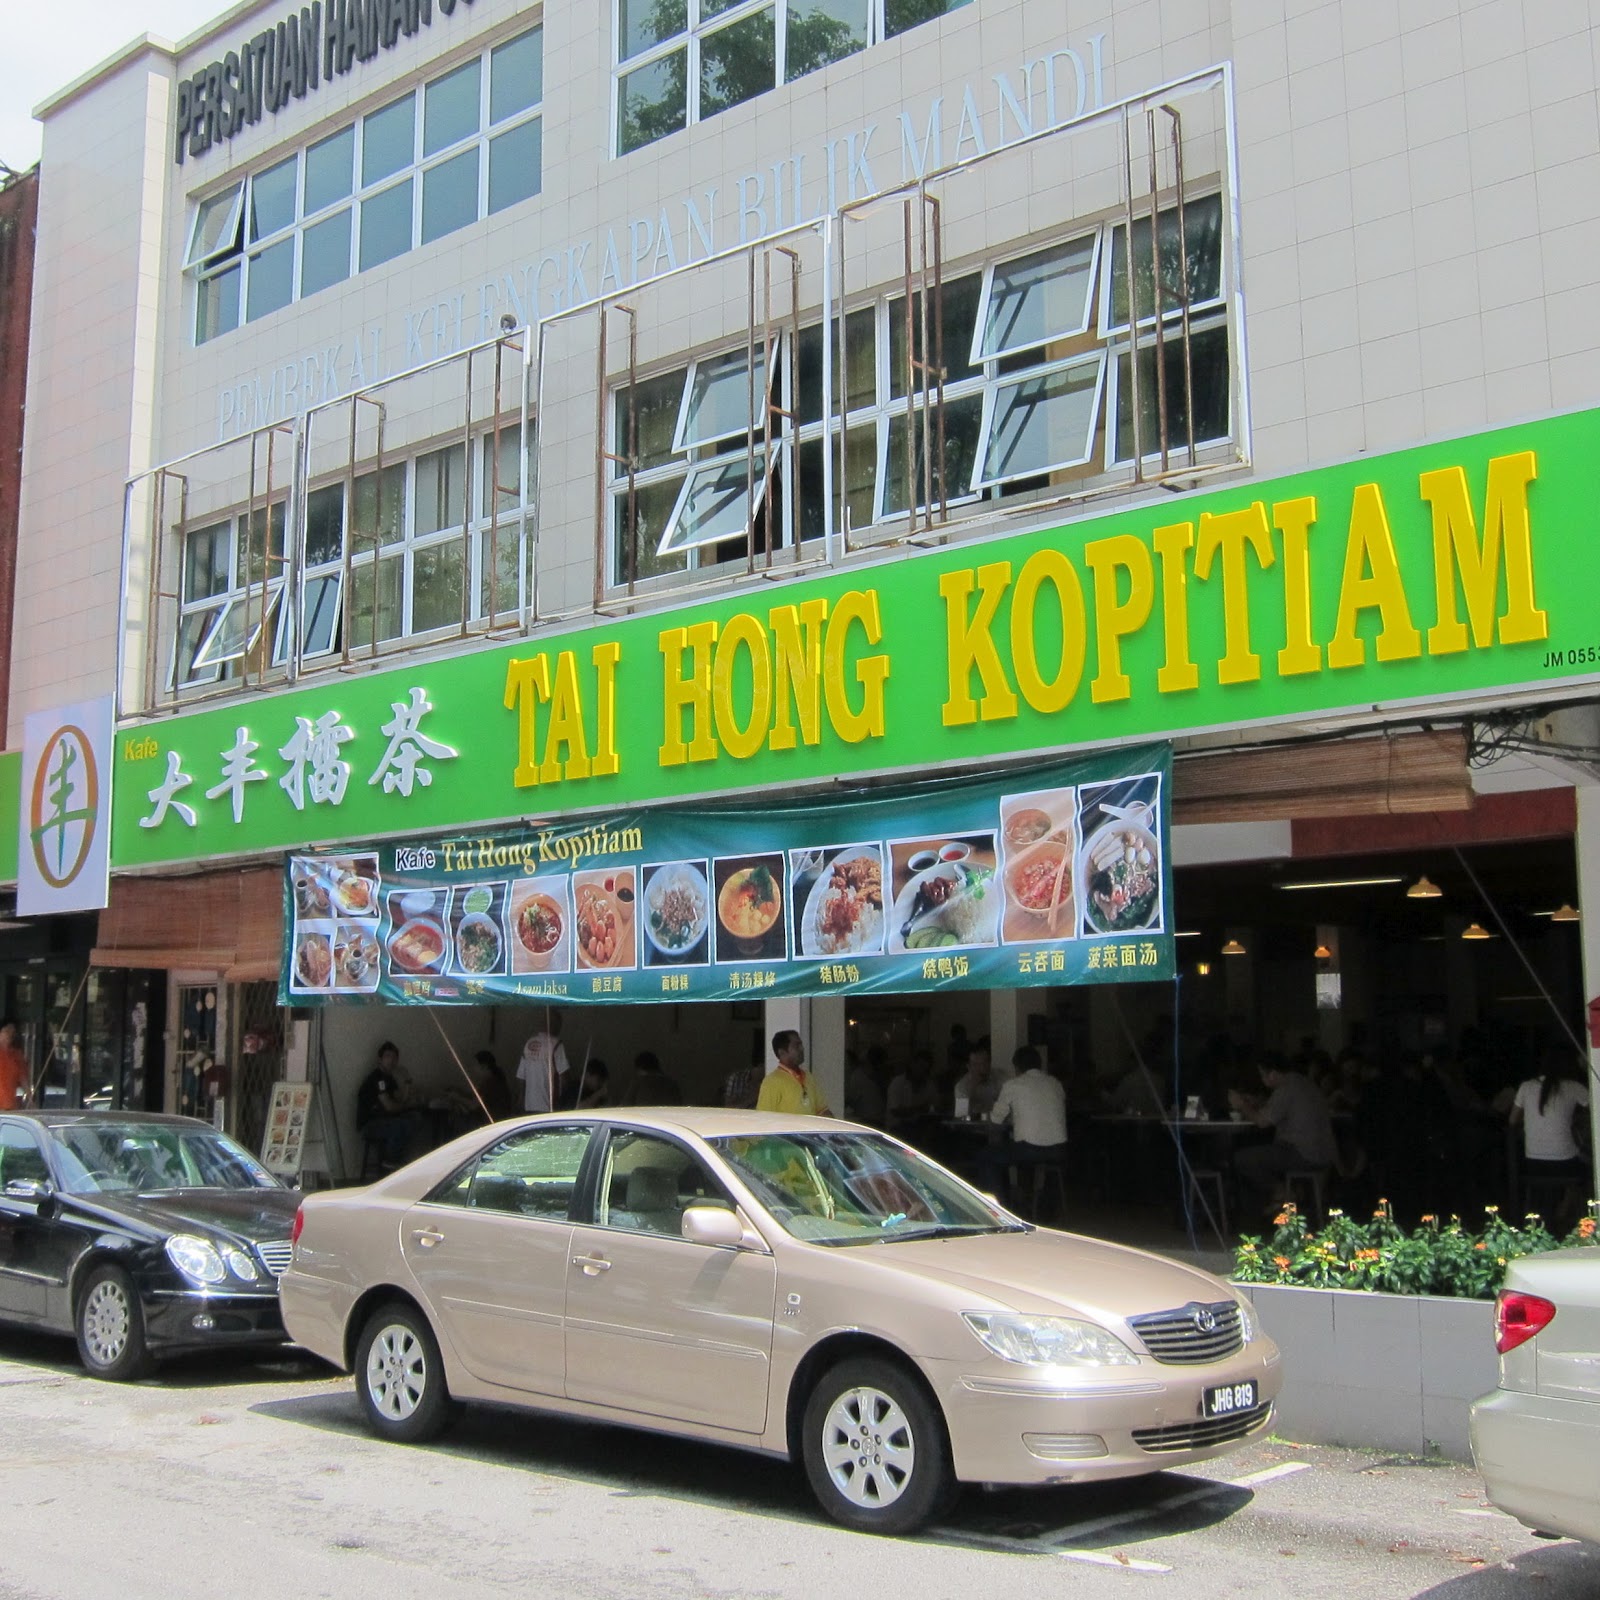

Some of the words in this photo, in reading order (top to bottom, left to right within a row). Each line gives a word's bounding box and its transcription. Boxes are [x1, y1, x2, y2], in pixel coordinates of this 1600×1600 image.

[176, 0, 321, 164] PERSATUAN
[404, 188, 720, 360] KELENGKAPAN
[736, 125, 877, 246] BILIK
[899, 34, 1108, 183] MANDI
[503, 642, 620, 788] TAI
[658, 589, 889, 767] HONG
[939, 451, 1548, 726] KOPITIAM
[1543, 651, 1563, 668] JM
[1568, 646, 1600, 665] 055
[124, 737, 158, 761] Kafe
[395, 847, 436, 871] Kafe
[442, 841, 473, 872] Tai
[477, 838, 536, 875] Hong
[537, 823, 642, 868] Kopitiam
[922, 956, 969, 979] 烧鸭饭
[1018, 950, 1065, 973] 云吞面
[1087, 942, 1158, 969] 菠菜面汤
[819, 965, 860, 984] 猪肠粉
[512, 981, 541, 994] Asam
[544, 980, 568, 995] laksa
[1211, 1387, 1233, 1413] JHG
[1234, 1383, 1253, 1408] 819
